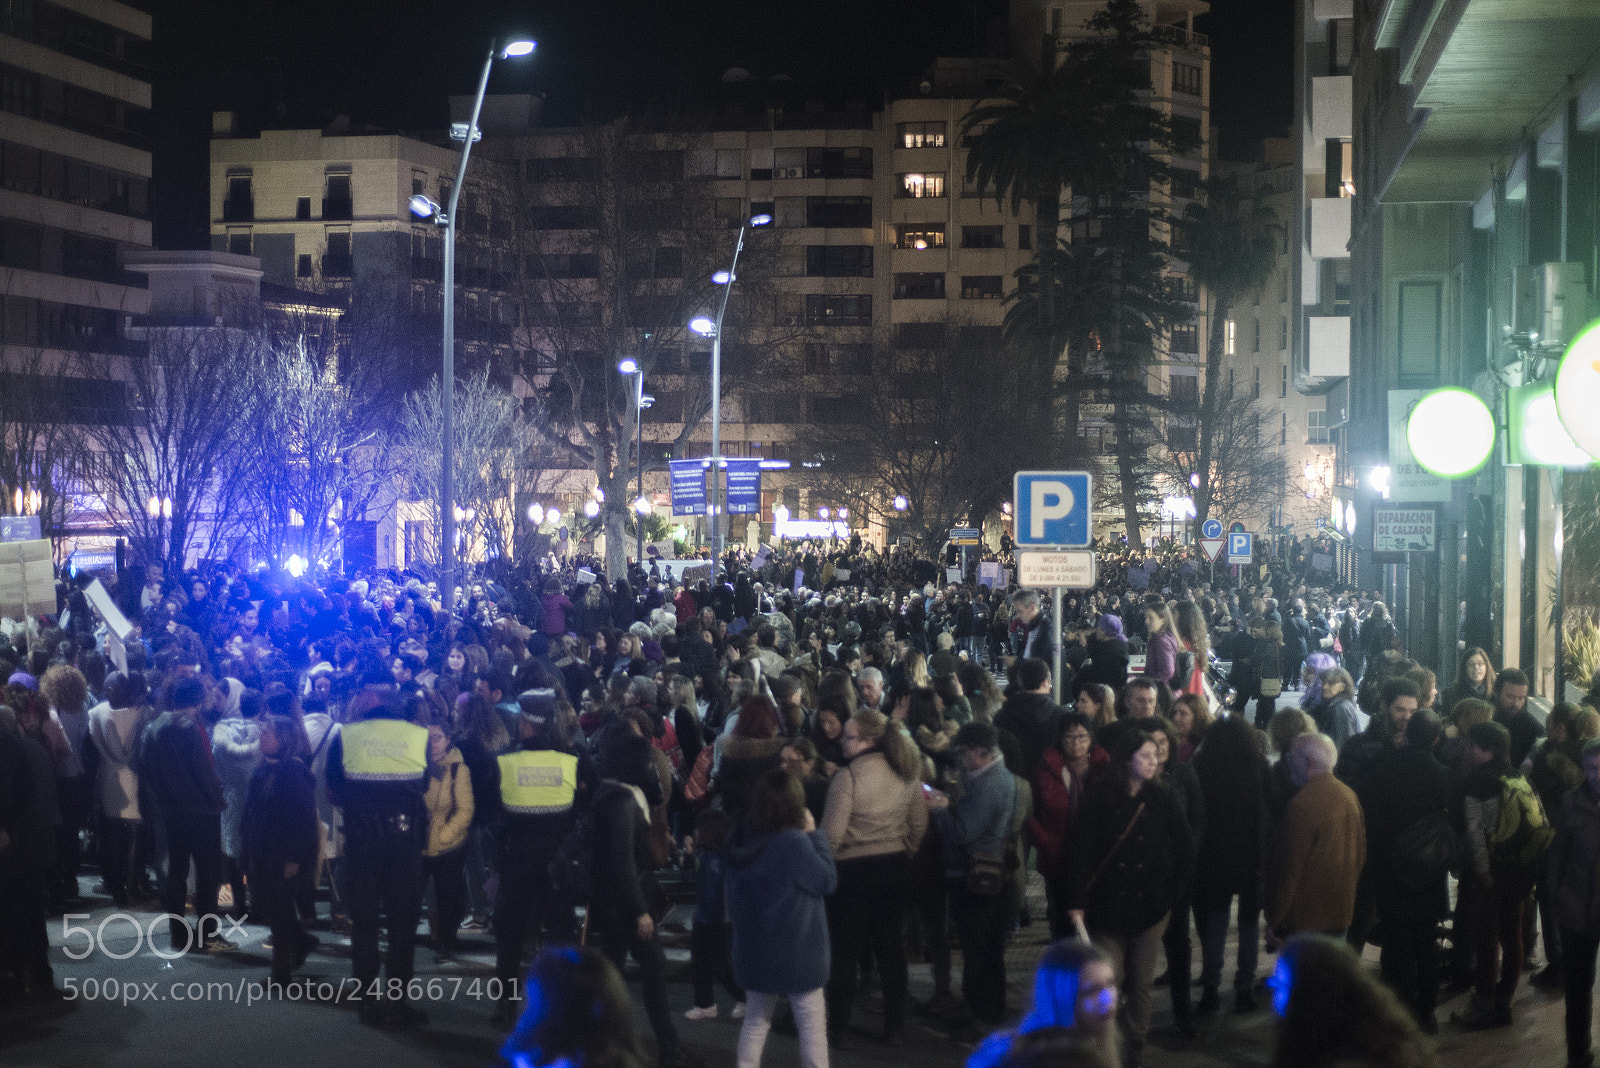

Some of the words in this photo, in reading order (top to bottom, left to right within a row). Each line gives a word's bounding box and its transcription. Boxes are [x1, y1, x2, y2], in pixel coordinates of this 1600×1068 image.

[1397, 464, 1412, 474] DE
[1030, 481, 1075, 538] P
[1378, 525, 1390, 535] DE
[1392, 525, 1432, 535] CALZADO
[1233, 535, 1247, 553] P
[1042, 555, 1068, 563] MOTOS
[1023, 565, 1031, 573] DE
[1033, 565, 1054, 573] LUNES
[1029, 574, 1037, 582] DE
[1056, 574, 1061, 582] A
